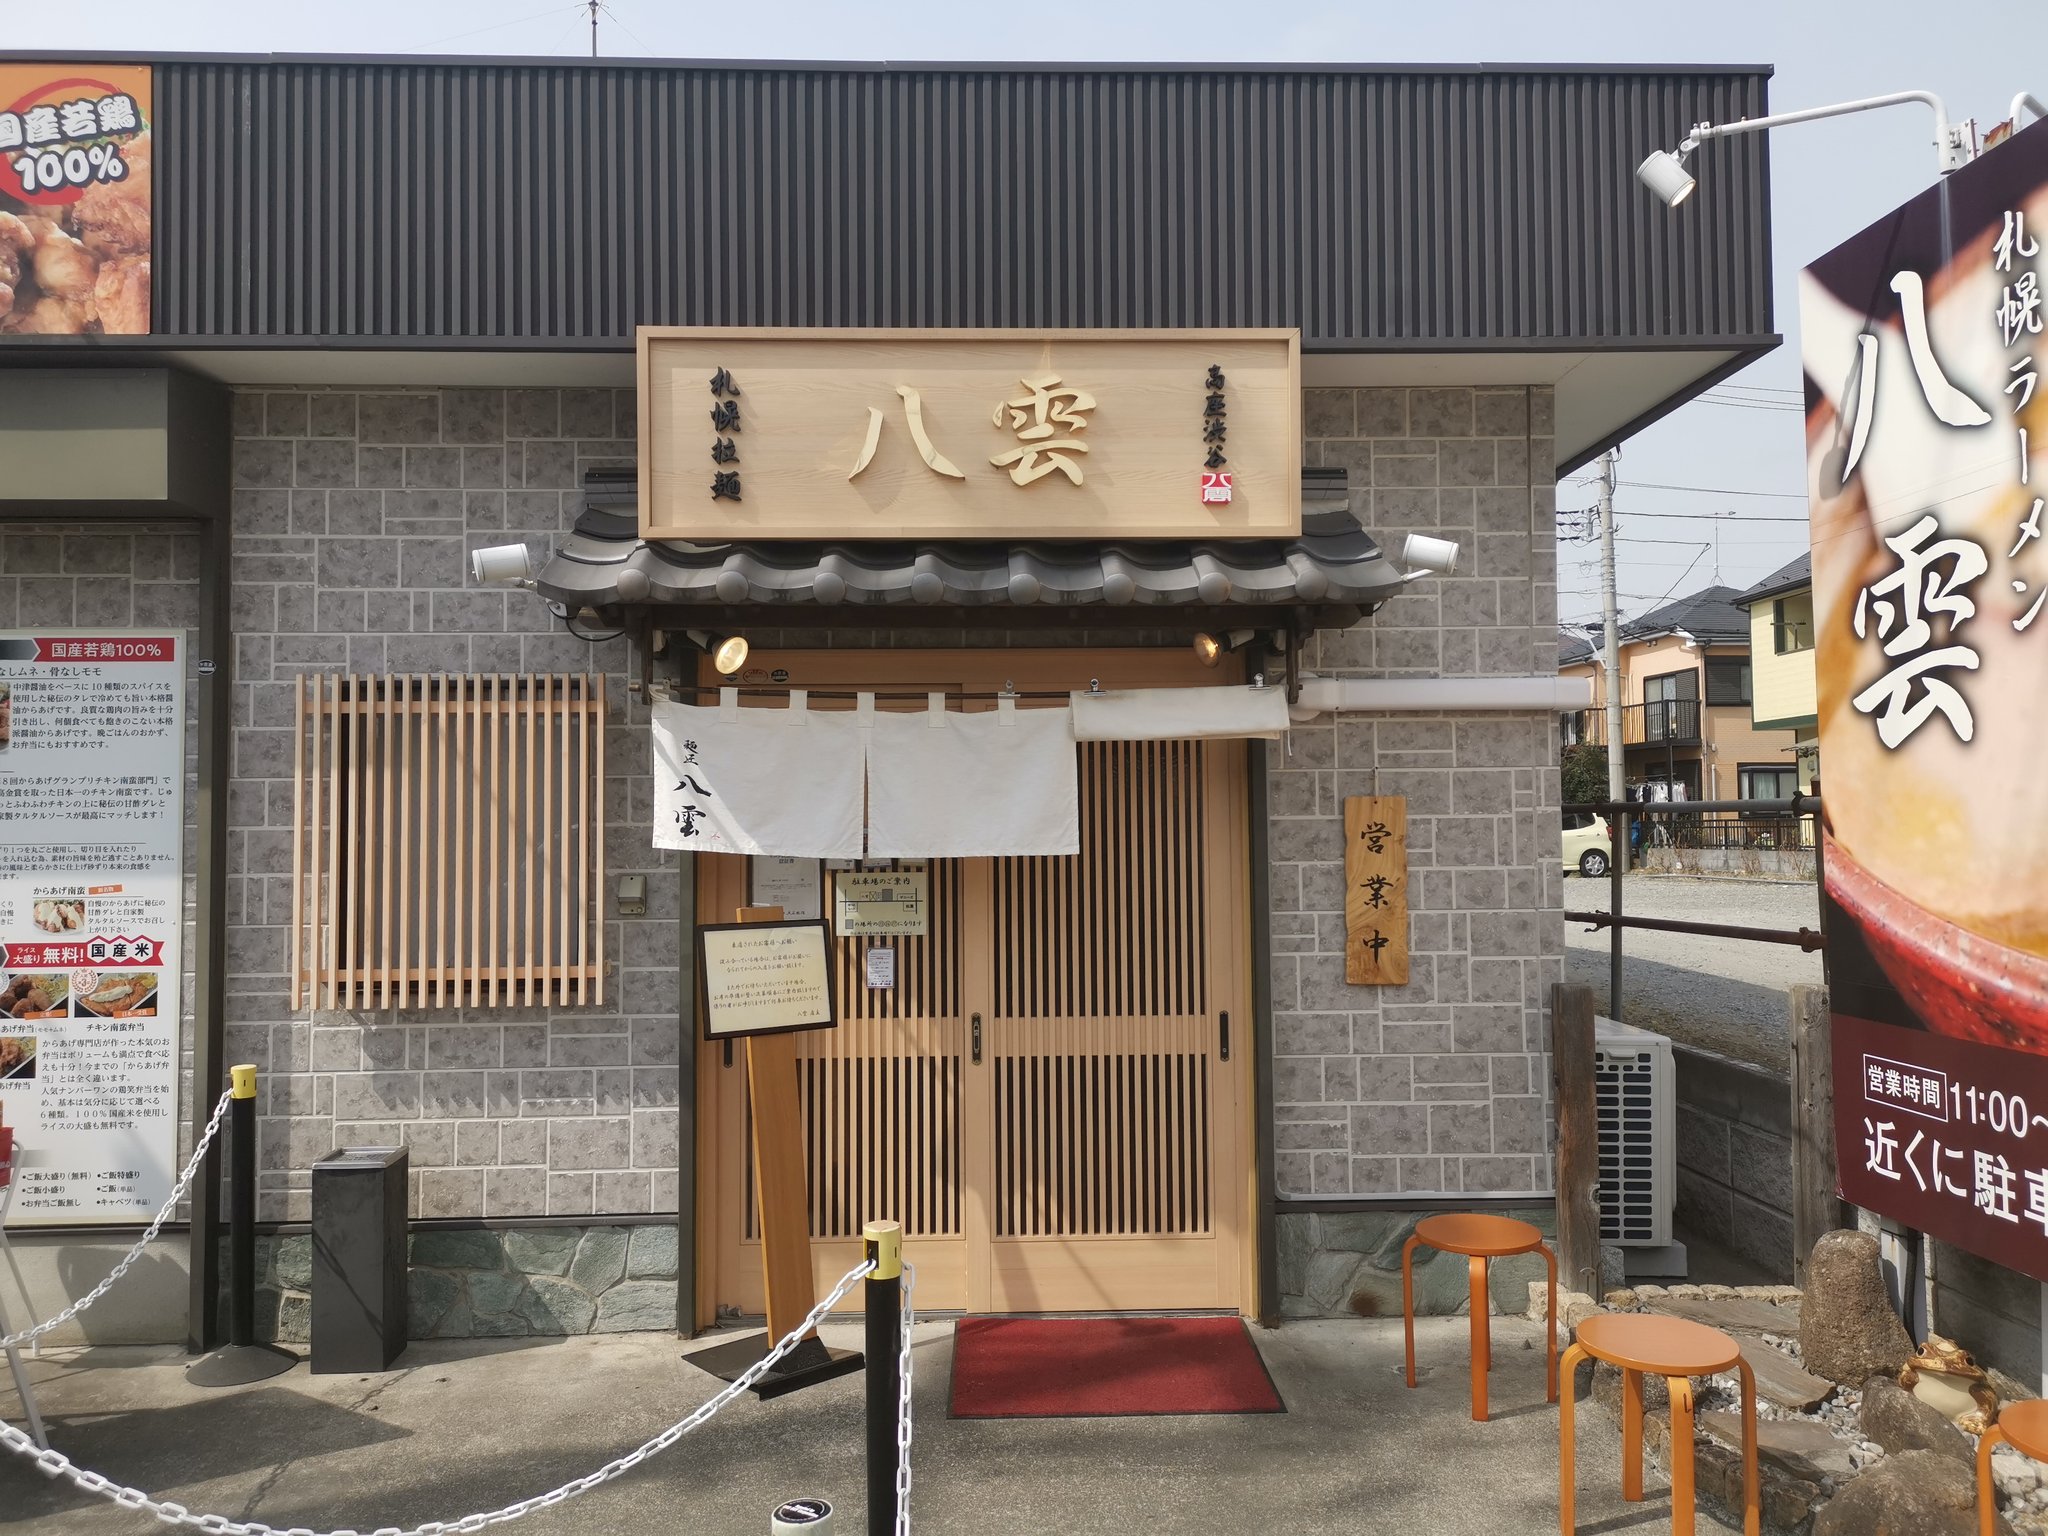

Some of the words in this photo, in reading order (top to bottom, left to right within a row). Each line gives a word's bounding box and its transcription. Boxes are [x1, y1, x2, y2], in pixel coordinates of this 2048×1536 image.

[14, 144, 124, 191] 100%
[1203, 364, 1227, 469] 高座渋谷
[1992, 209, 2048, 633] 札幌ラーメン
[847, 373, 1098, 488] 八雲
[1841, 270, 1992, 750] 八雲
[51, 643, 161, 657] 国産若鶏100%
[12, 740, 109, 749] お弁当にもおすすめです。
[0, 776, 171, 786] 8回からあげグランプリチキン南蛮部門」で
[673, 774, 712, 837] 八雲
[0, 846, 137, 854] り1つを丸ごと使用し、切り目を入れたり
[0, 863, 151, 871] の風味と柔らかさに仕上げ砂ずり本来の食感を
[851, 876, 911, 886] 駐車場のご案内
[33, 886, 85, 896] からあげ南蛮
[1360, 821, 1393, 964] 営業中
[88, 917, 165, 925] タルタルソースでお召し
[91, 943, 150, 958] 国産米
[13, 954, 40, 964] 大盛り
[86, 1023, 145, 1032] チキン南蛮弁当
[42, 1038, 170, 1048] からあげ専門店が作った本気のお
[42, 1050, 170, 1060] 弁当はボリュームも満点で食べ応
[41, 1074, 131, 1084] 当」とは全く違います。
[41, 1085, 169, 1095] 人気ナンバーワンの鶏笑弁当を始
[1868, 1064, 1941, 1110] 営業時間
[41, 1097, 160, 1107] め、基本は気分に応じて選べる
[40, 1121, 139, 1131] ライスの大盛も無料です。
[101, 1171, 140, 1179] ご飯特盛り
[26, 1186, 65, 1194] ご飯小盛り
[26, 1199, 81, 1207] お弁当ご飯無し
